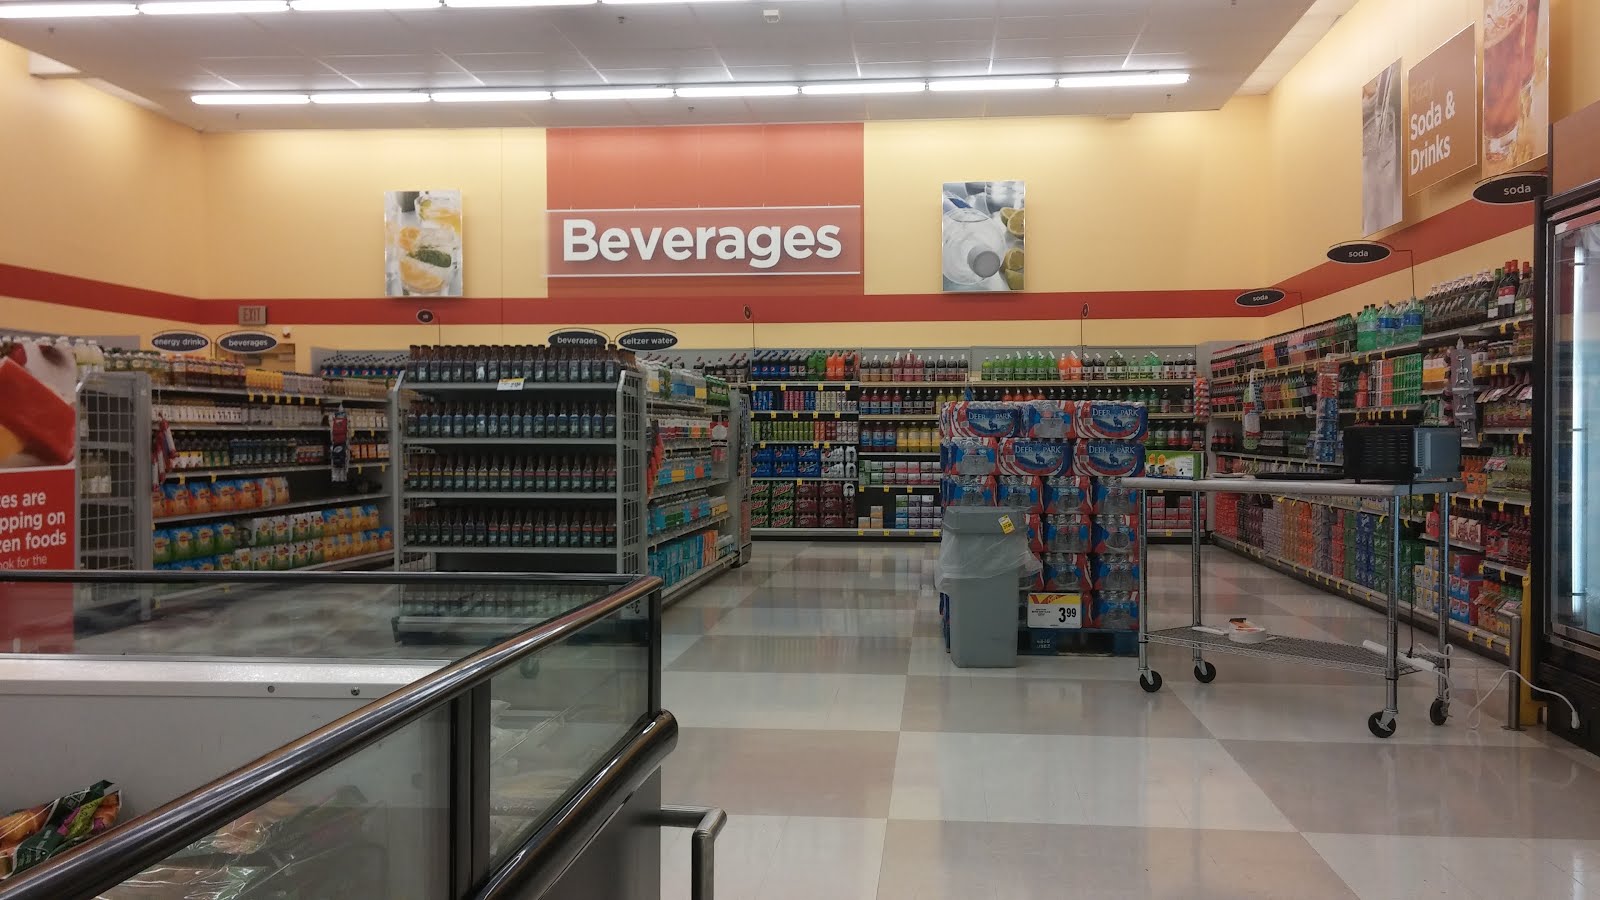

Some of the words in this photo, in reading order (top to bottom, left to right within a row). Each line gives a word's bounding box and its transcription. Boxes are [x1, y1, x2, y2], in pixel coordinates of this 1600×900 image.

[1410, 101, 1442, 140] Soda
[1446, 90, 1456, 120] &
[1410, 134, 1451, 176] Drinks
[1504, 184, 1532, 196] soda
[563, 218, 842, 268] Beverages
[1348, 250, 1369, 258] soda
[243, 307, 261, 321] EXIT
[182, 338, 206, 346] drinks
[228, 339, 268, 347] beverages
[557, 336, 598, 345] beverages
[996, 412, 1012, 420] PARK
[1092, 408, 1112, 416] DEER
[1120, 408, 1140, 416] PARK
[1015, 446, 1033, 454] DEER
[1042, 446, 1062, 454] PARK
[1088, 446, 1108, 454] DEER
[1116, 446, 1136, 454] PARK
[22, 492, 46, 506] are
[48, 511, 66, 526] on
[26, 530, 66, 550] foods
[17, 556, 30, 568] for
[32, 554, 48, 565] the
